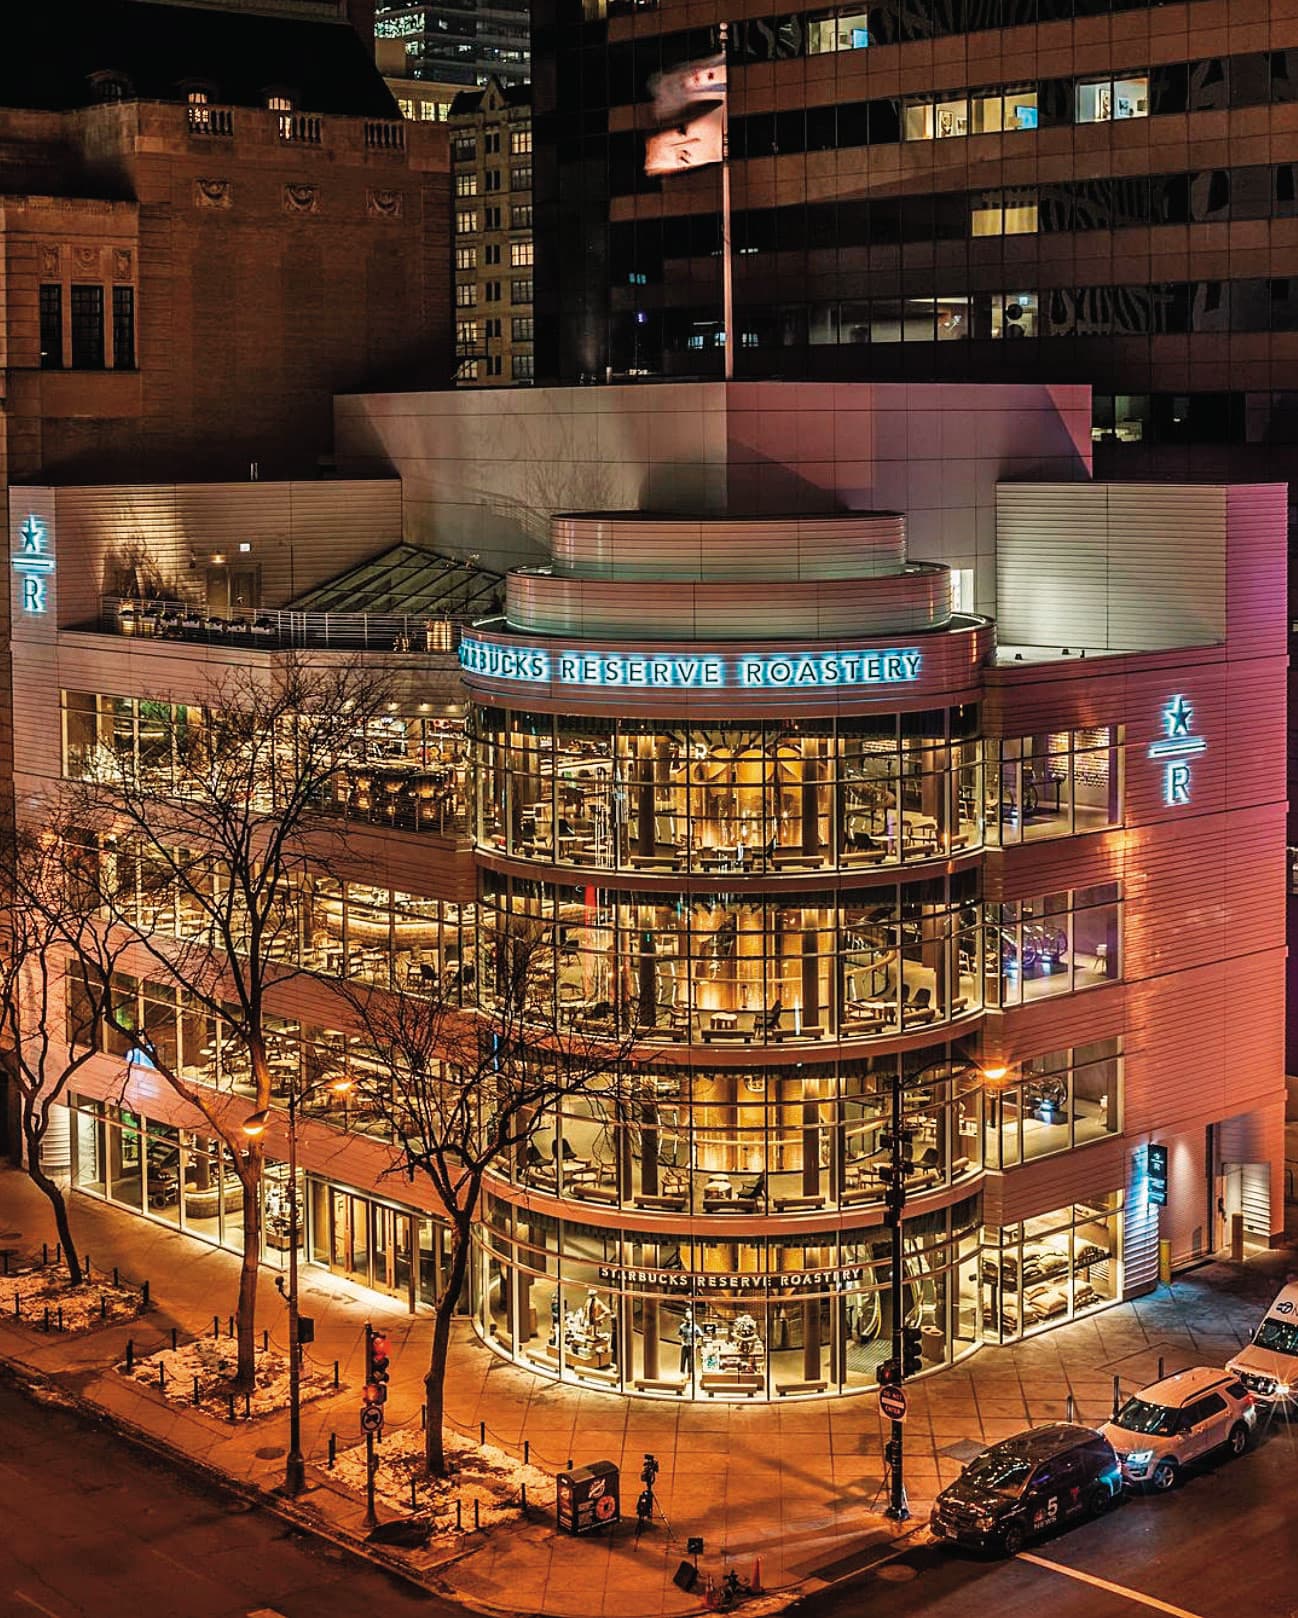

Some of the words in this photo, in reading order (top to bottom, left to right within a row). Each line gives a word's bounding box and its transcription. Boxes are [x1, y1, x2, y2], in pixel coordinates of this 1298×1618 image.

[23, 578, 39, 609] R
[561, 659, 719, 683] RESERVE
[746, 655, 920, 683] ROASTERY
[1171, 766, 1191, 802] R
[1047, 1495, 1058, 1517] 5
